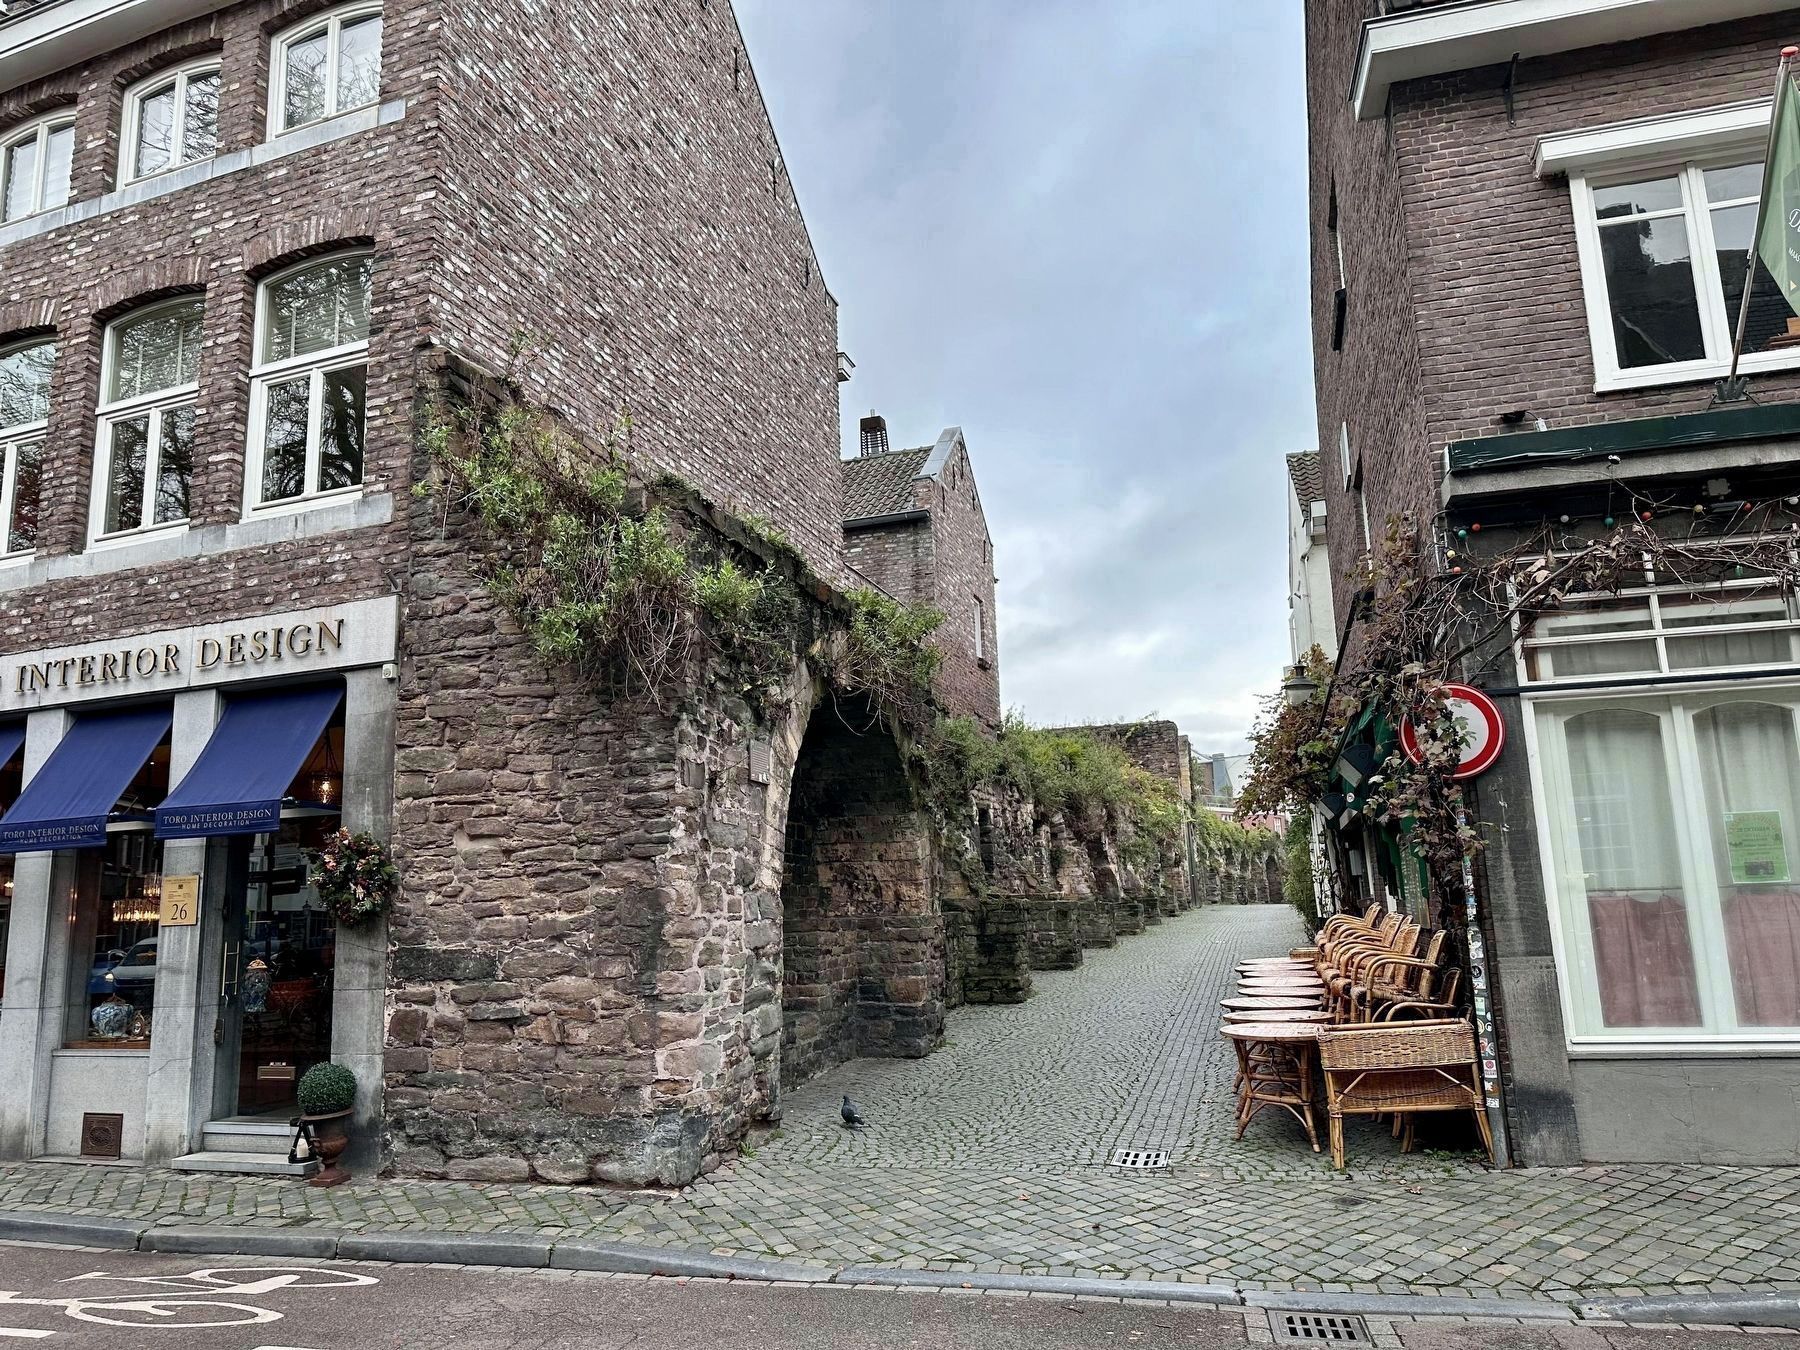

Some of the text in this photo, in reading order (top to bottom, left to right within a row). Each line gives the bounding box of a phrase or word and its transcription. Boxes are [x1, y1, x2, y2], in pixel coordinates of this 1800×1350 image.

[14, 618, 345, 693] INTERIOR DESIGN
[163, 809, 272, 824] TORO INTERIOR DESIGN
[203, 820, 250, 829] DECORATION
[3, 824, 99, 840] TORO INTERIOR DESIGN
[170, 902, 188, 921] 26
